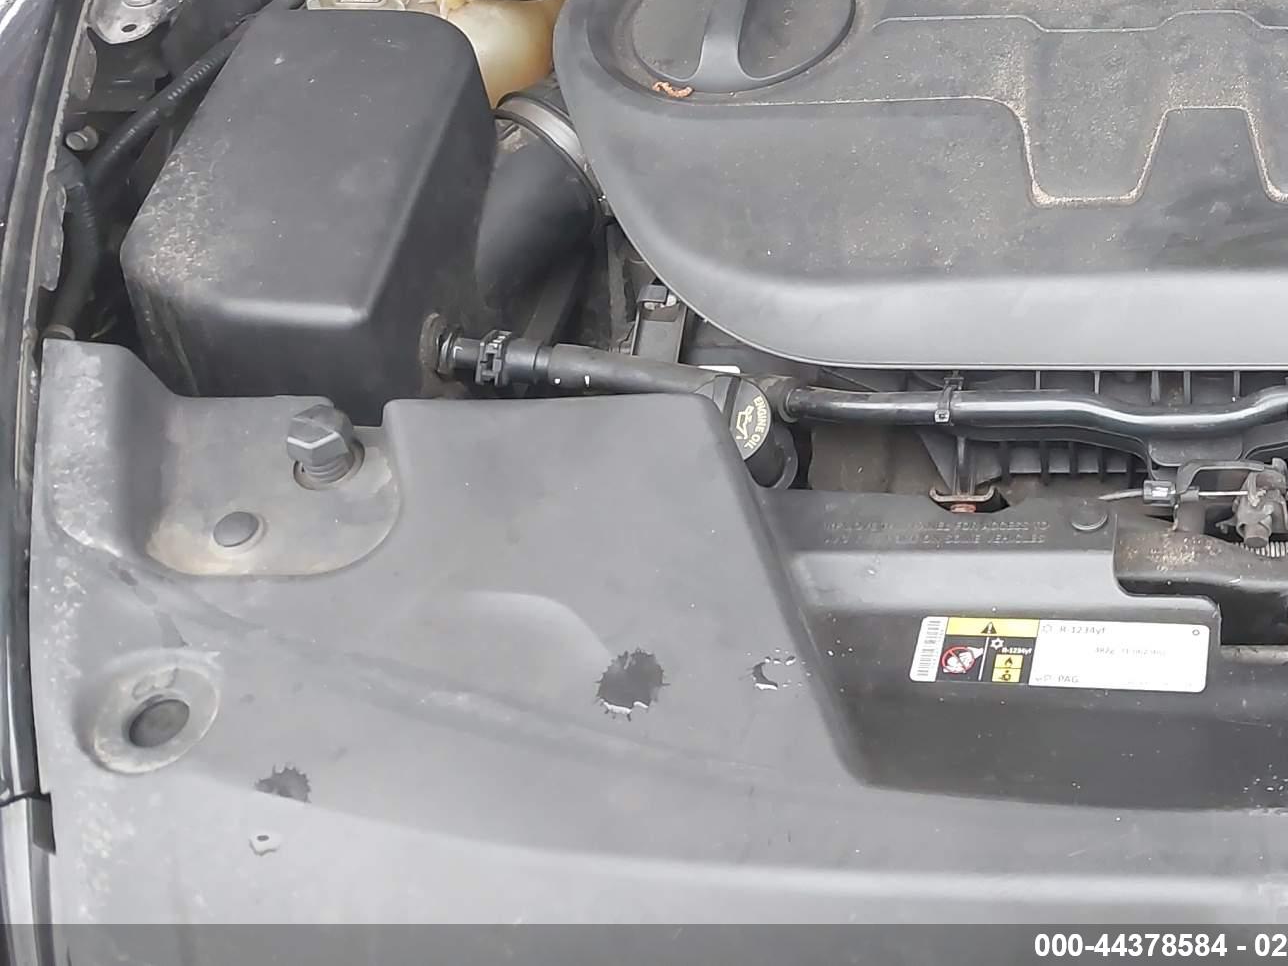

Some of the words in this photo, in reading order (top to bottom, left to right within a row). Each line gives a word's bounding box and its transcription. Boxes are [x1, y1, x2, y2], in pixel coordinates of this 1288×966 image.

[753, 395, 768, 434] ENGINE
[744, 434, 761, 449] OIL
[1058, 674, 1080, 684] PAG
